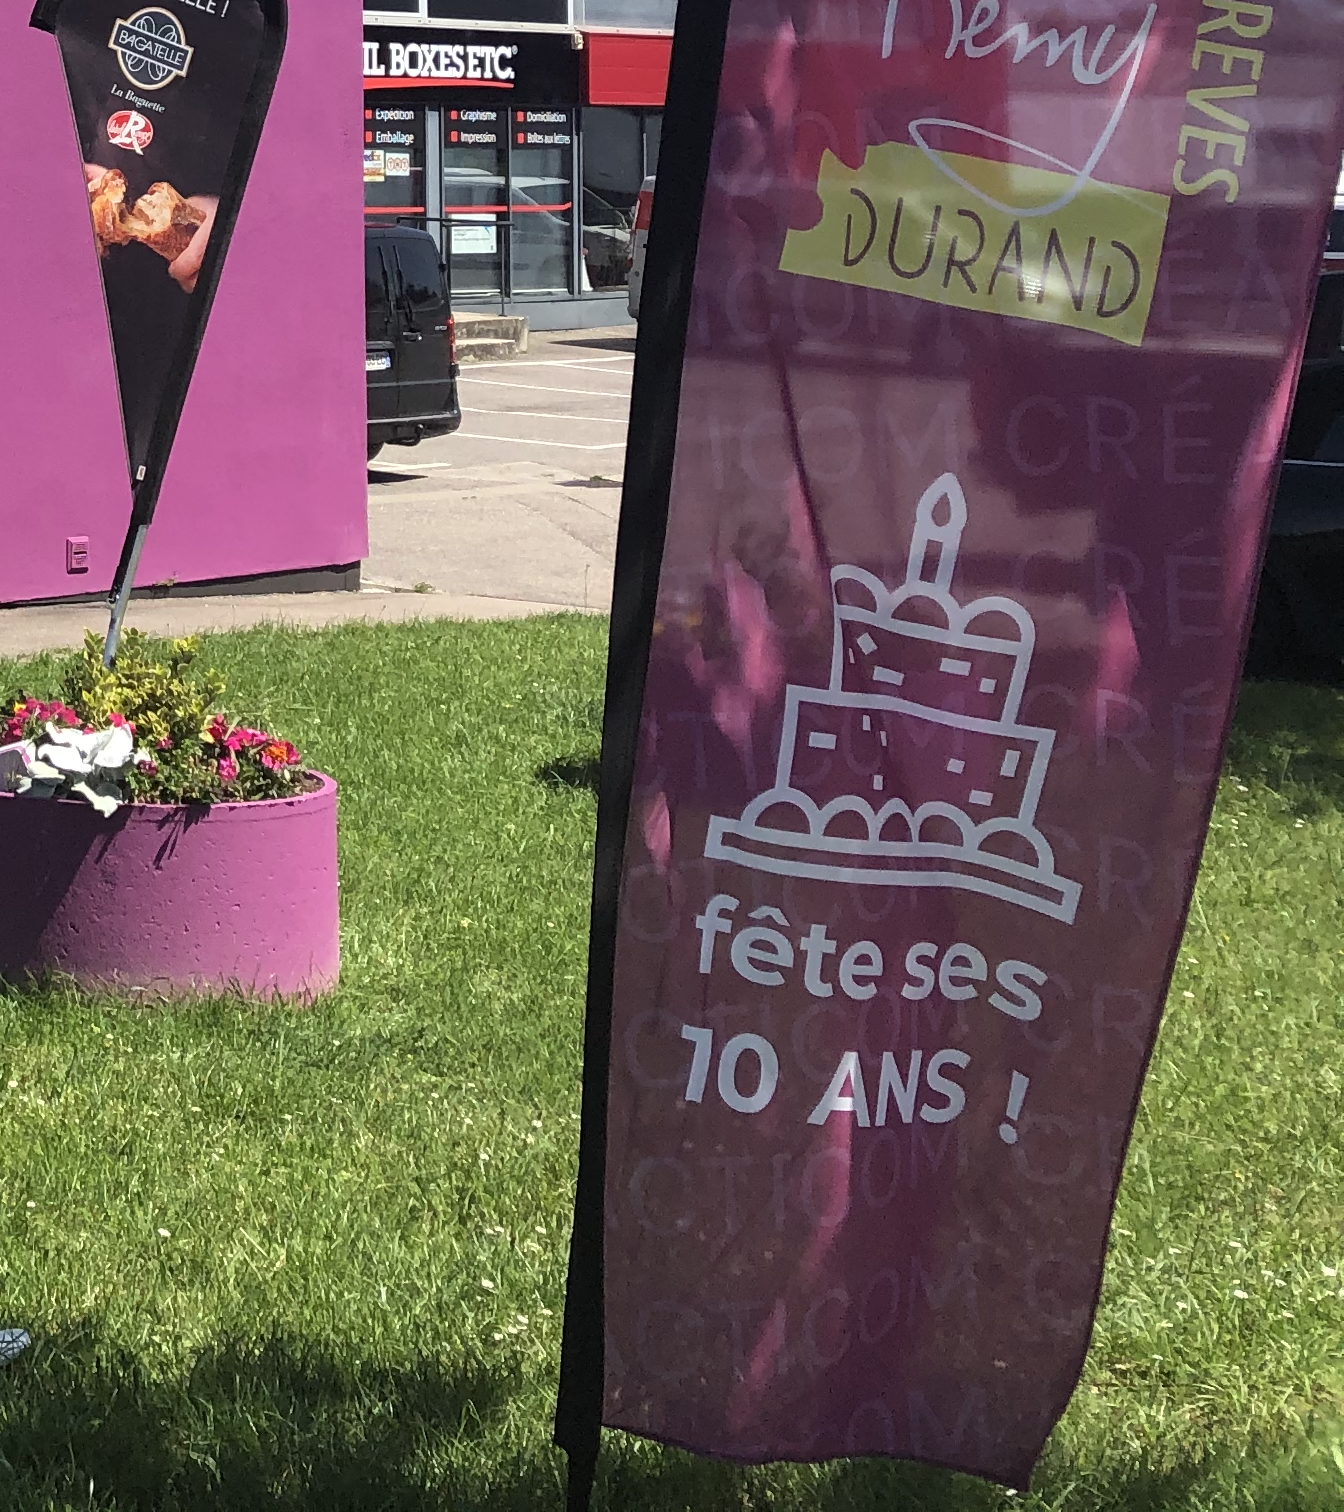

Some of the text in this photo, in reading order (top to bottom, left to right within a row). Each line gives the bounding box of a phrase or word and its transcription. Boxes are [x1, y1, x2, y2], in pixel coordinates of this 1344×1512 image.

[118, 29, 185, 66] BAGATELLE
[389, 43, 465, 78] BOXES
[111, 83, 165, 113] La Baguette
[376, 108, 414, 121] Expédition
[461, 108, 497, 122] Graphisme
[527, 111, 566, 123] Domiciliation
[376, 131, 414, 146] Emballage
[461, 131, 496, 144] Impression
[843, 188, 1140, 318] DURAND
[695, 894, 1048, 1021] fête ses
[681, 1024, 779, 1113] 10
[807, 1048, 971, 1128] ANS
